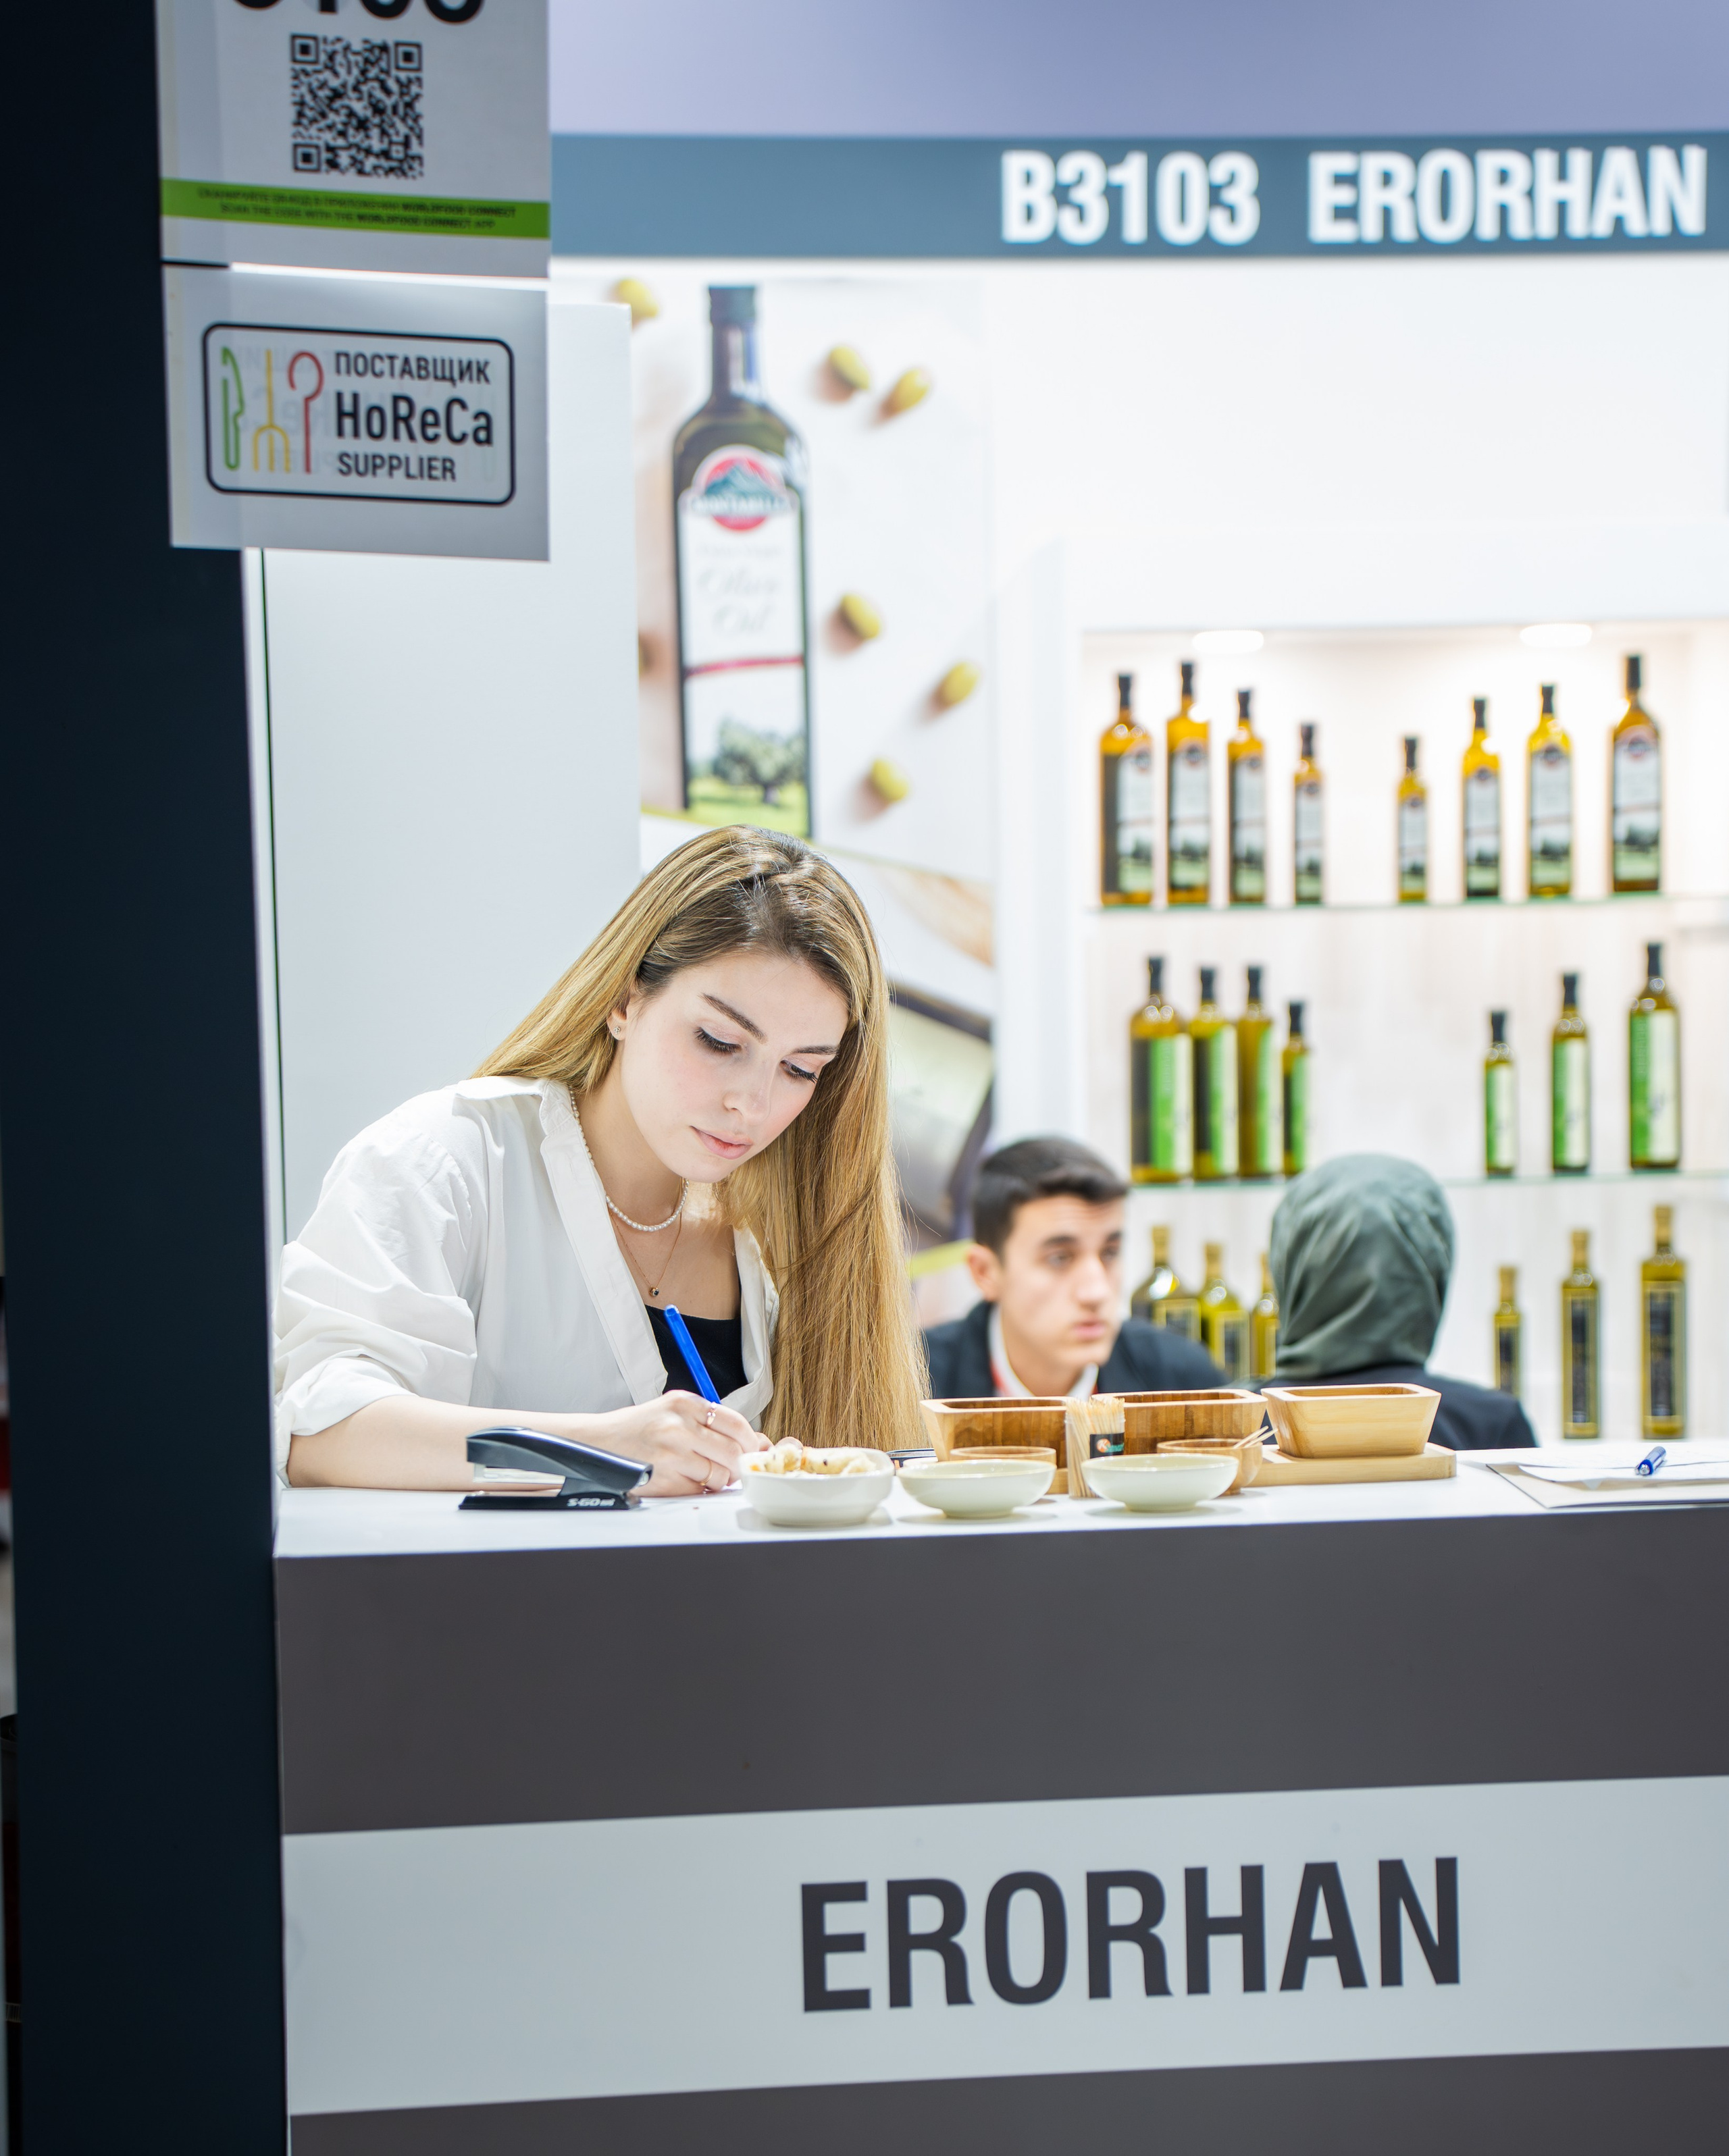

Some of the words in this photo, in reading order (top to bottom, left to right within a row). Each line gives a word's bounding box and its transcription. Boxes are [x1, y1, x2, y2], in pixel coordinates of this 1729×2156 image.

[1000, 149, 1261, 246] B3103
[1306, 143, 1709, 244] ERORHAN
[335, 350, 490, 387] ПОСТАВЩИК
[336, 390, 494, 447] HoReCa
[338, 452, 457, 481] SUPPLIER
[800, 1856, 1461, 2013] ERORHAN
